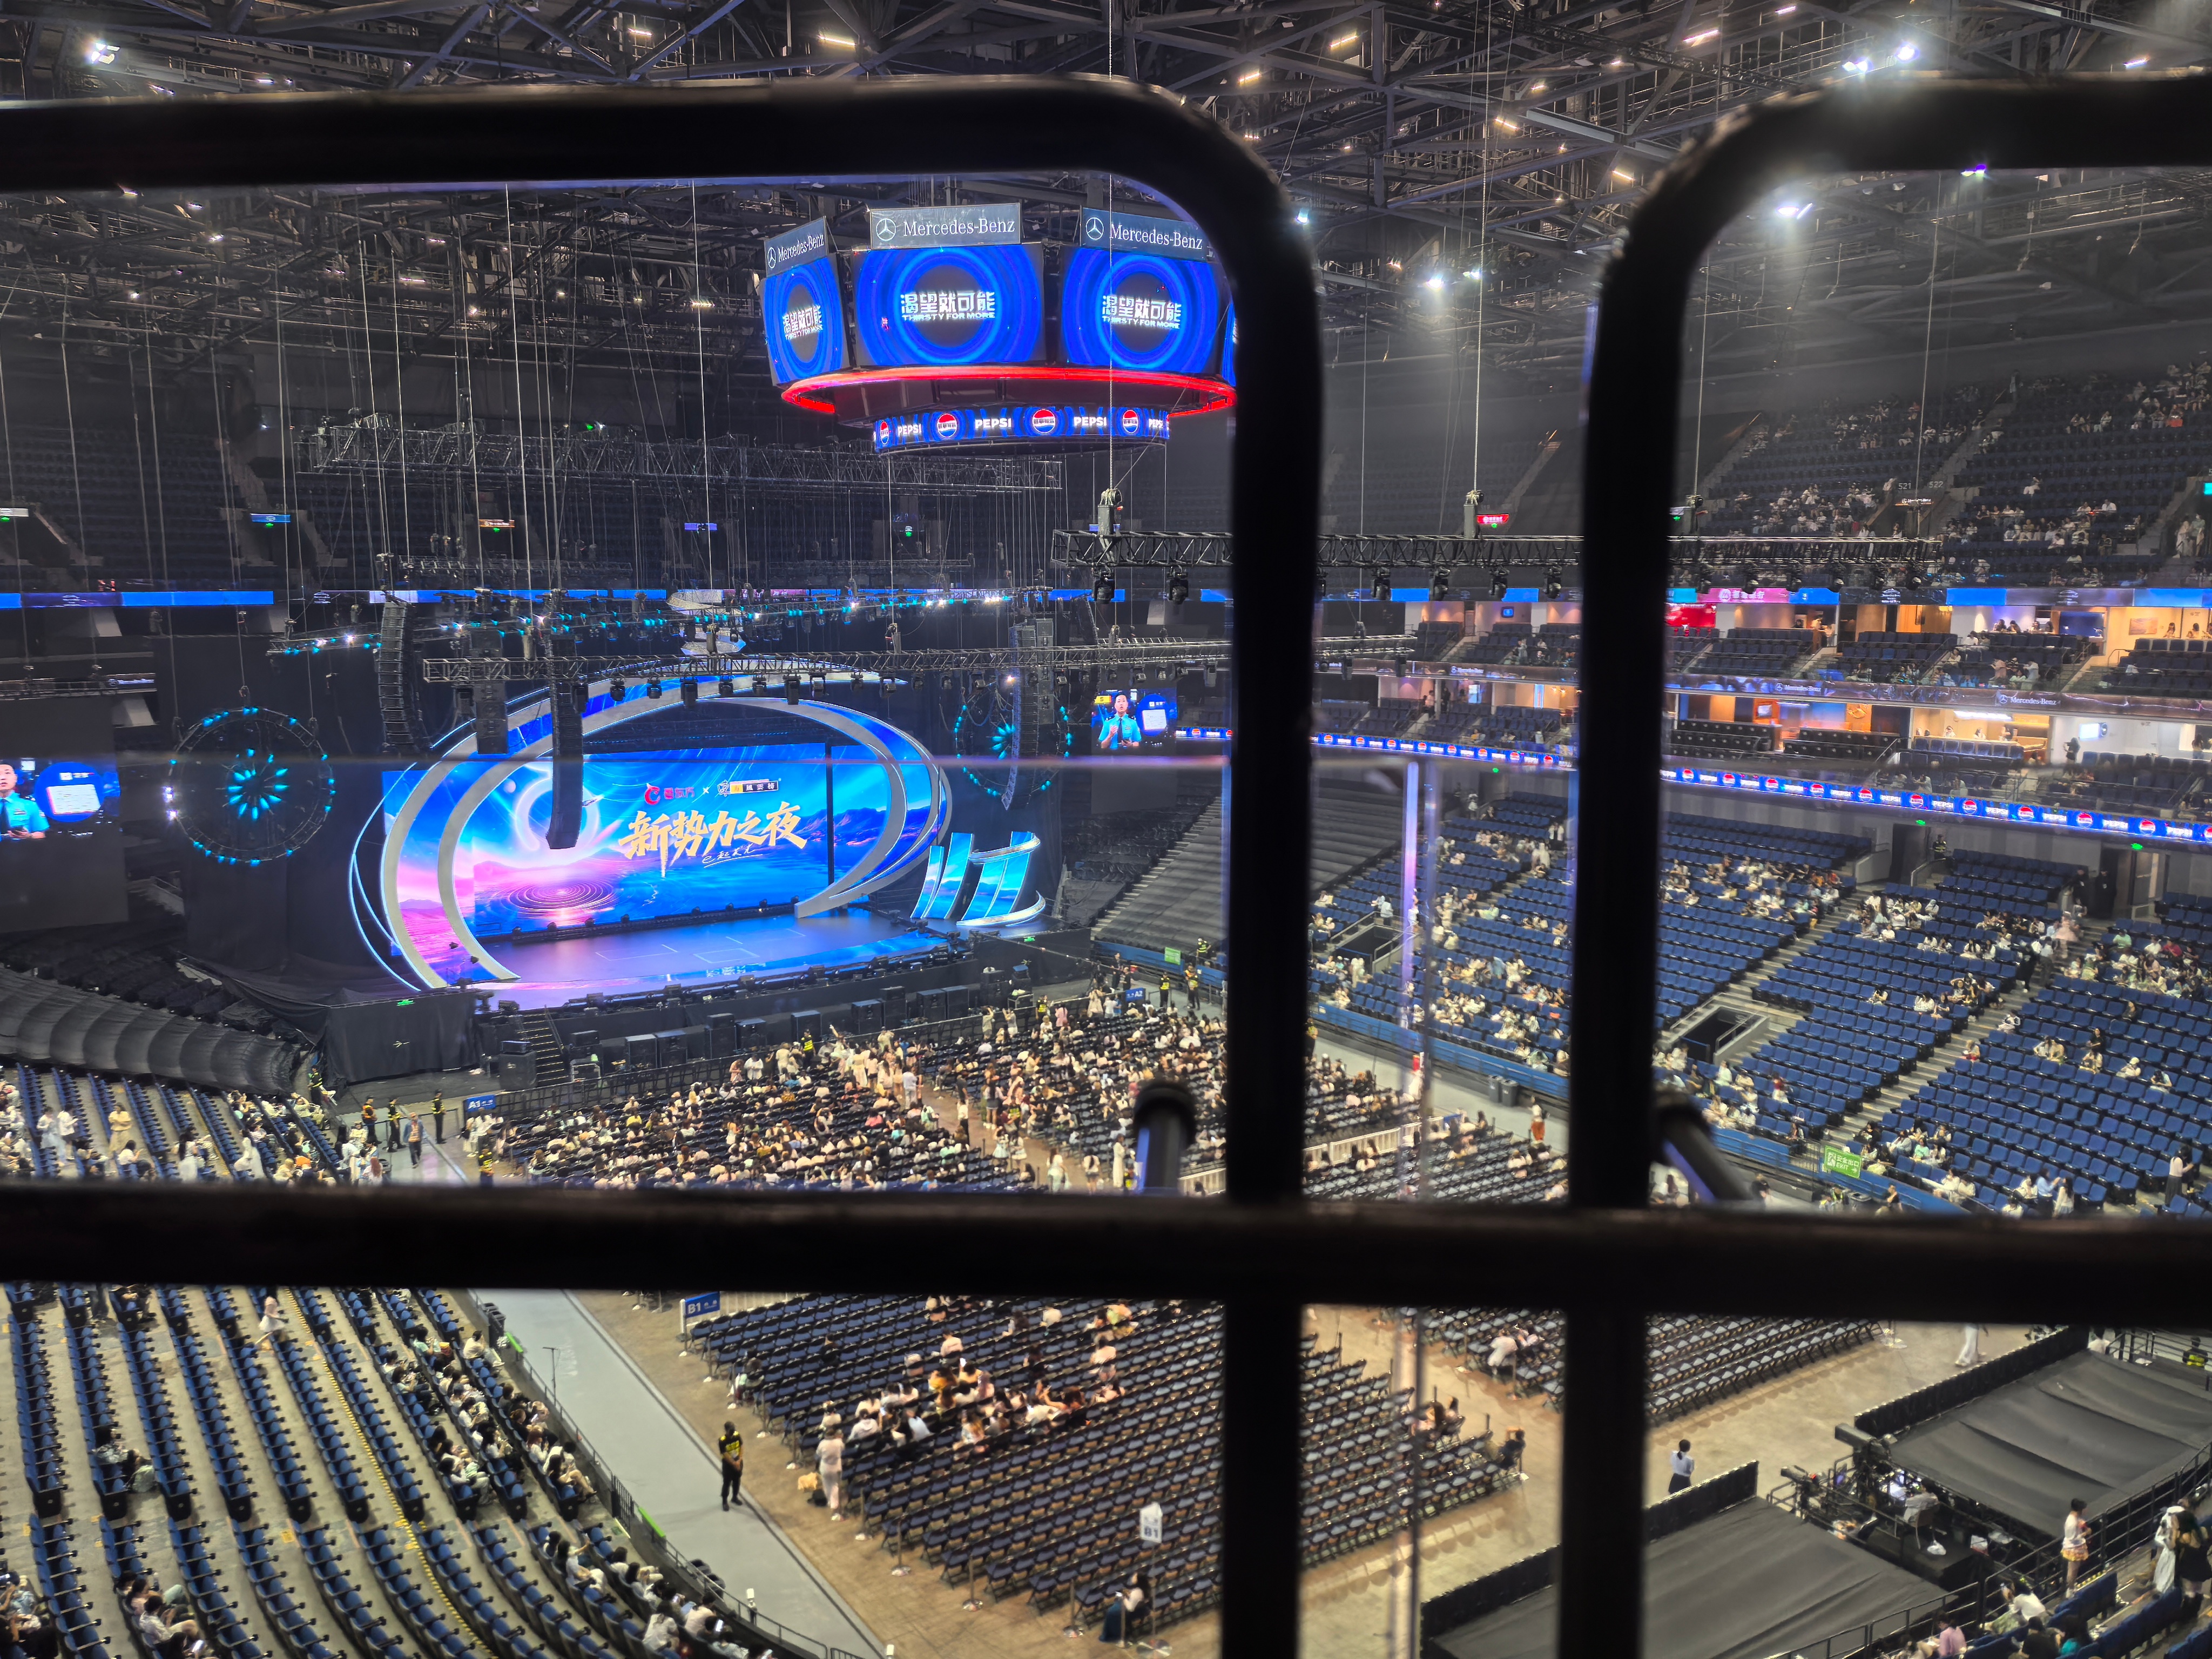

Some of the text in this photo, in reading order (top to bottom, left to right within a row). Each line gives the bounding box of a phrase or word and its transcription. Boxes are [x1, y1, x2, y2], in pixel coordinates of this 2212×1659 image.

[903, 218, 1015, 237] Mercedes-Benz
[1110, 224, 1203, 249] Mercedes-Benz
[778, 234, 824, 262] Mercedes-Benz
[900, 292, 995, 314] 渴望就可能
[1102, 295, 1182, 322] 渴望就可能
[783, 305, 822, 333] 渴望就可能
[901, 313, 945, 321] THIRSTY
[1102, 316, 1139, 326] THIRSTY
[1139, 319, 1156, 327] FOR
[785, 325, 824, 340] THIRSTY FOR MORE
[975, 418, 1011, 429] PEPSI
[1074, 416, 1107, 427] PEPSI
[897, 423, 922, 436] PEPSI
[2010, 697, 2056, 705] Mercedes-Benz
[1987, 807, 2008, 815] PEPSI
[2044, 813, 2067, 821] PEPSI
[2105, 819, 2128, 828] PEPSI
[2169, 827, 2193, 837] PEPSI
[618, 801, 807, 878] 新势力之夜
[468, 1100, 481, 1109] A1
[1836, 1162, 1849, 1170] EXIT
[1837, 1155, 1859, 1167] 安全出口
[687, 1302, 701, 1314] B1
[1144, 1527, 1158, 1539] B1
